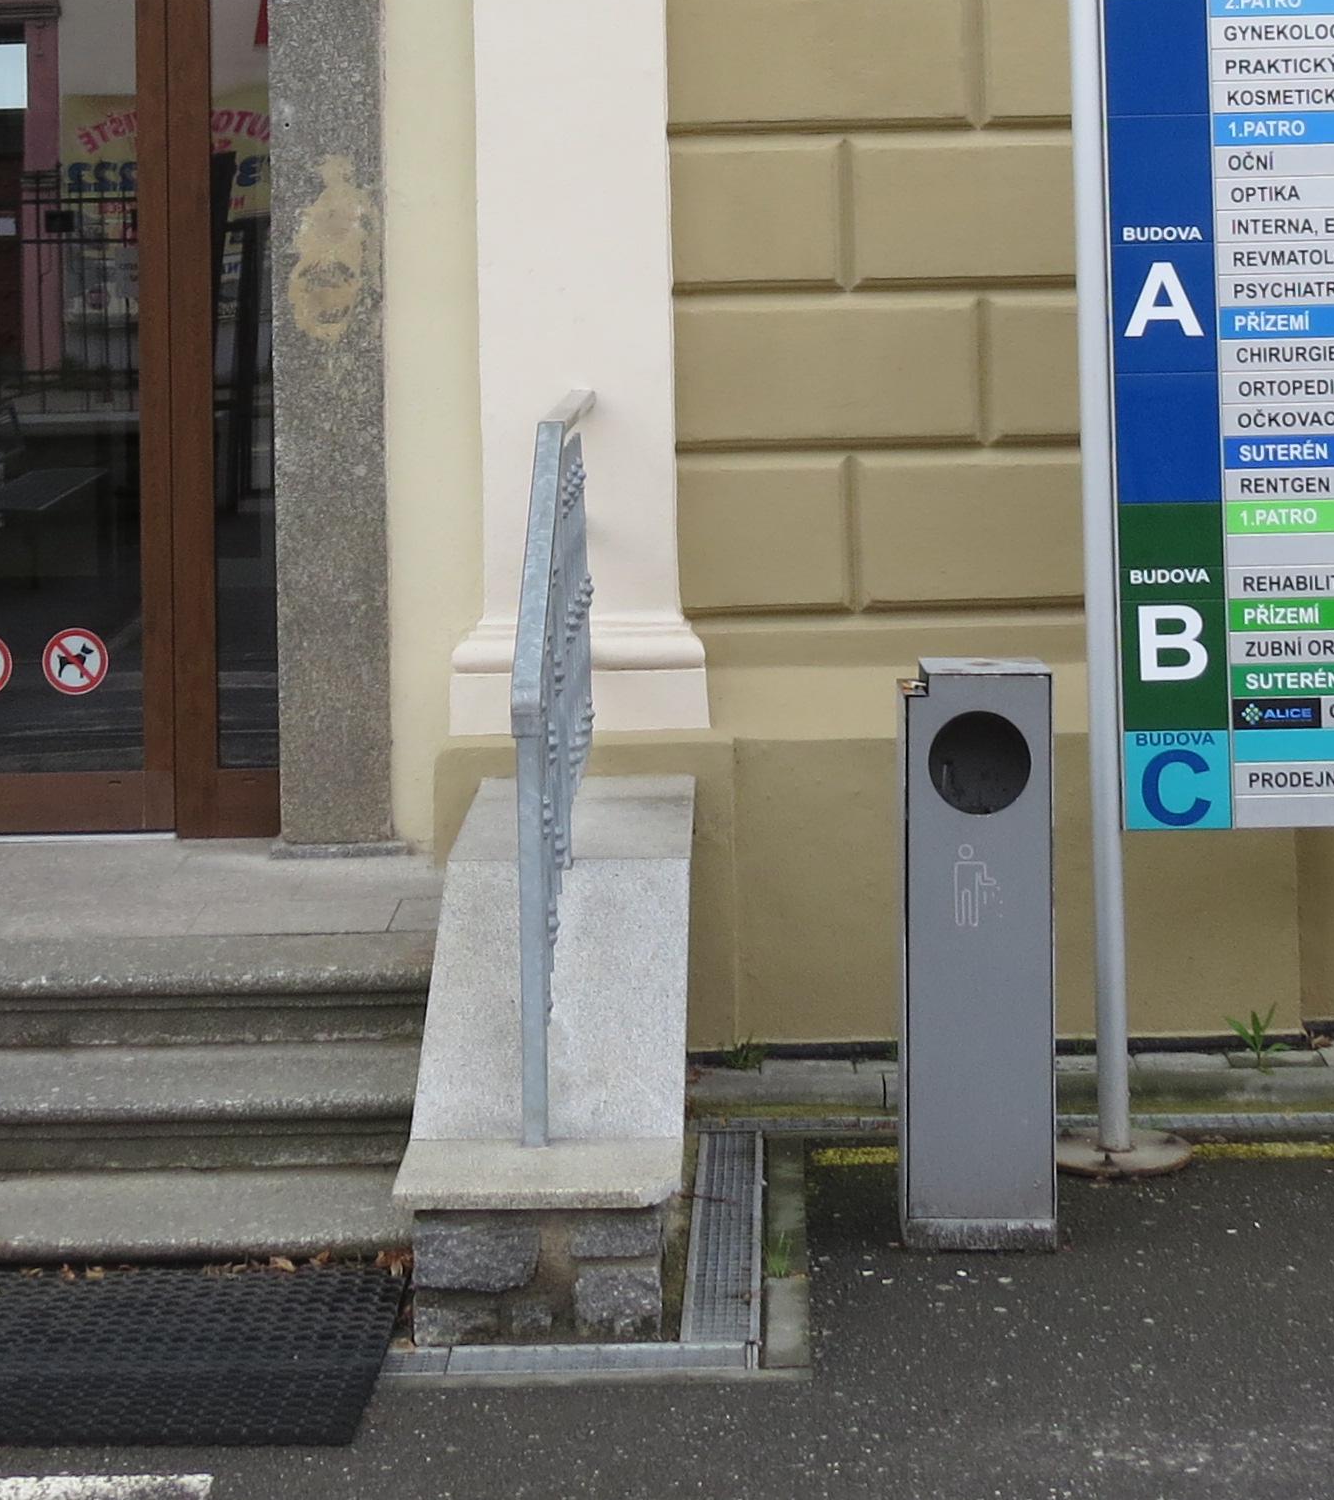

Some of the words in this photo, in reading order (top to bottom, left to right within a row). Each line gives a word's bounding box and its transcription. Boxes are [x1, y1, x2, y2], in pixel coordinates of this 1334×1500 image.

[1228, 119, 1305, 138] 1.PATRO
[1228, 151, 1273, 171] OČNÍ
[1230, 185, 1301, 203] OPTIKA
[1122, 226, 1203, 241] BUDOVA
[1232, 218, 1318, 235] INTERNA,
[1124, 261, 1204, 337] A
[1234, 310, 1309, 332] PŘÍZEMÍ
[1239, 439, 1328, 462] SUTERÉN
[1240, 477, 1330, 494] RENTGEN
[1240, 507, 1317, 526] 1.PATRO
[1129, 568, 1210, 585] BUDOVA
[1244, 603, 1320, 625] PŘÍZEMÍ
[1137, 604, 1208, 681] B
[1245, 636, 1302, 658] ZUBNÍ
[1264, 708, 1312, 719] ALICE
[1135, 731, 1215, 747] BUDOVA
[1141, 748, 1212, 827] C
